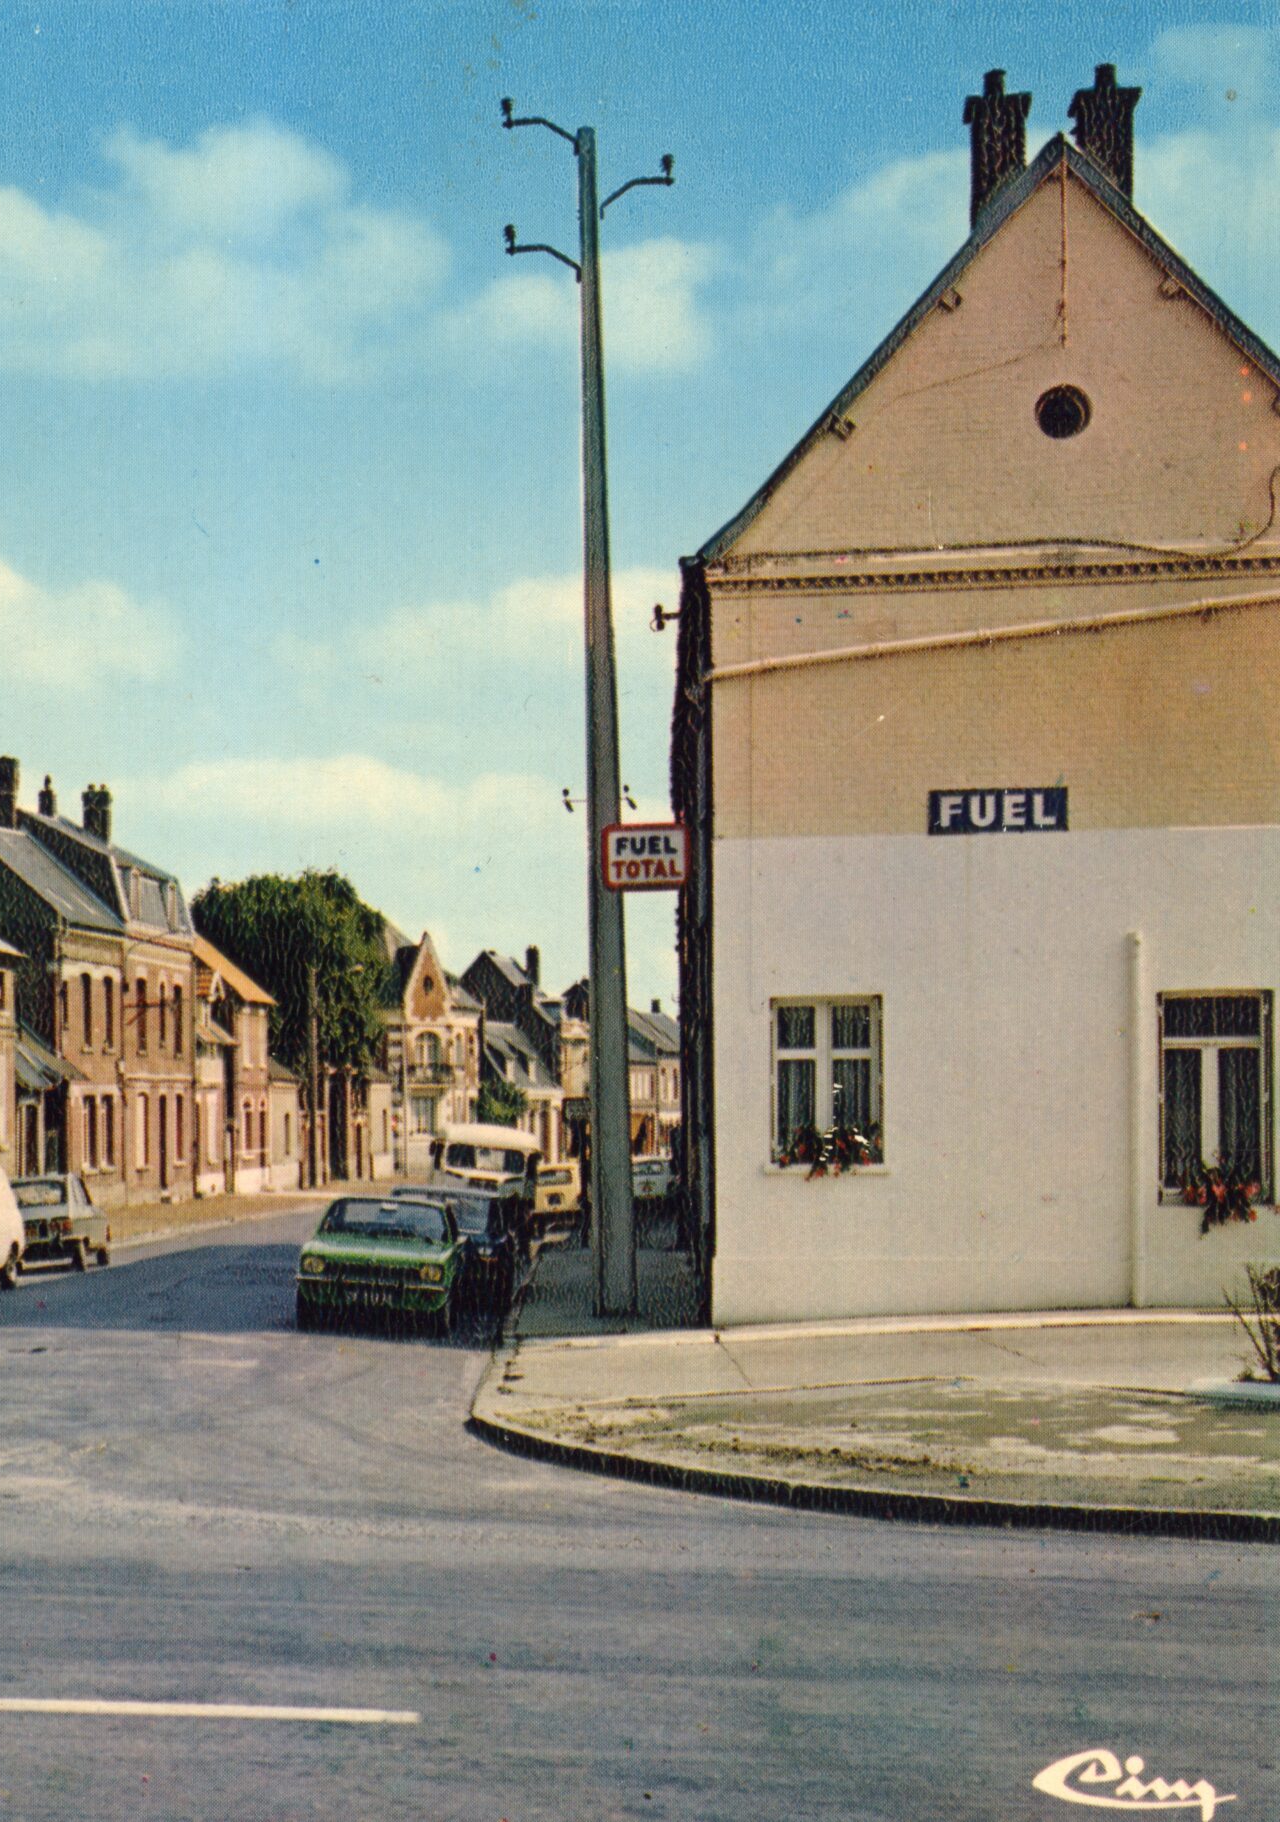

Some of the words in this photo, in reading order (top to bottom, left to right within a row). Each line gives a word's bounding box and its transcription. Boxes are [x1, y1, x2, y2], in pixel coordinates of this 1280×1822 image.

[939, 793, 1057, 828] FUEL
[615, 835, 679, 857] FUEL
[611, 858, 683, 879] TOTAL
